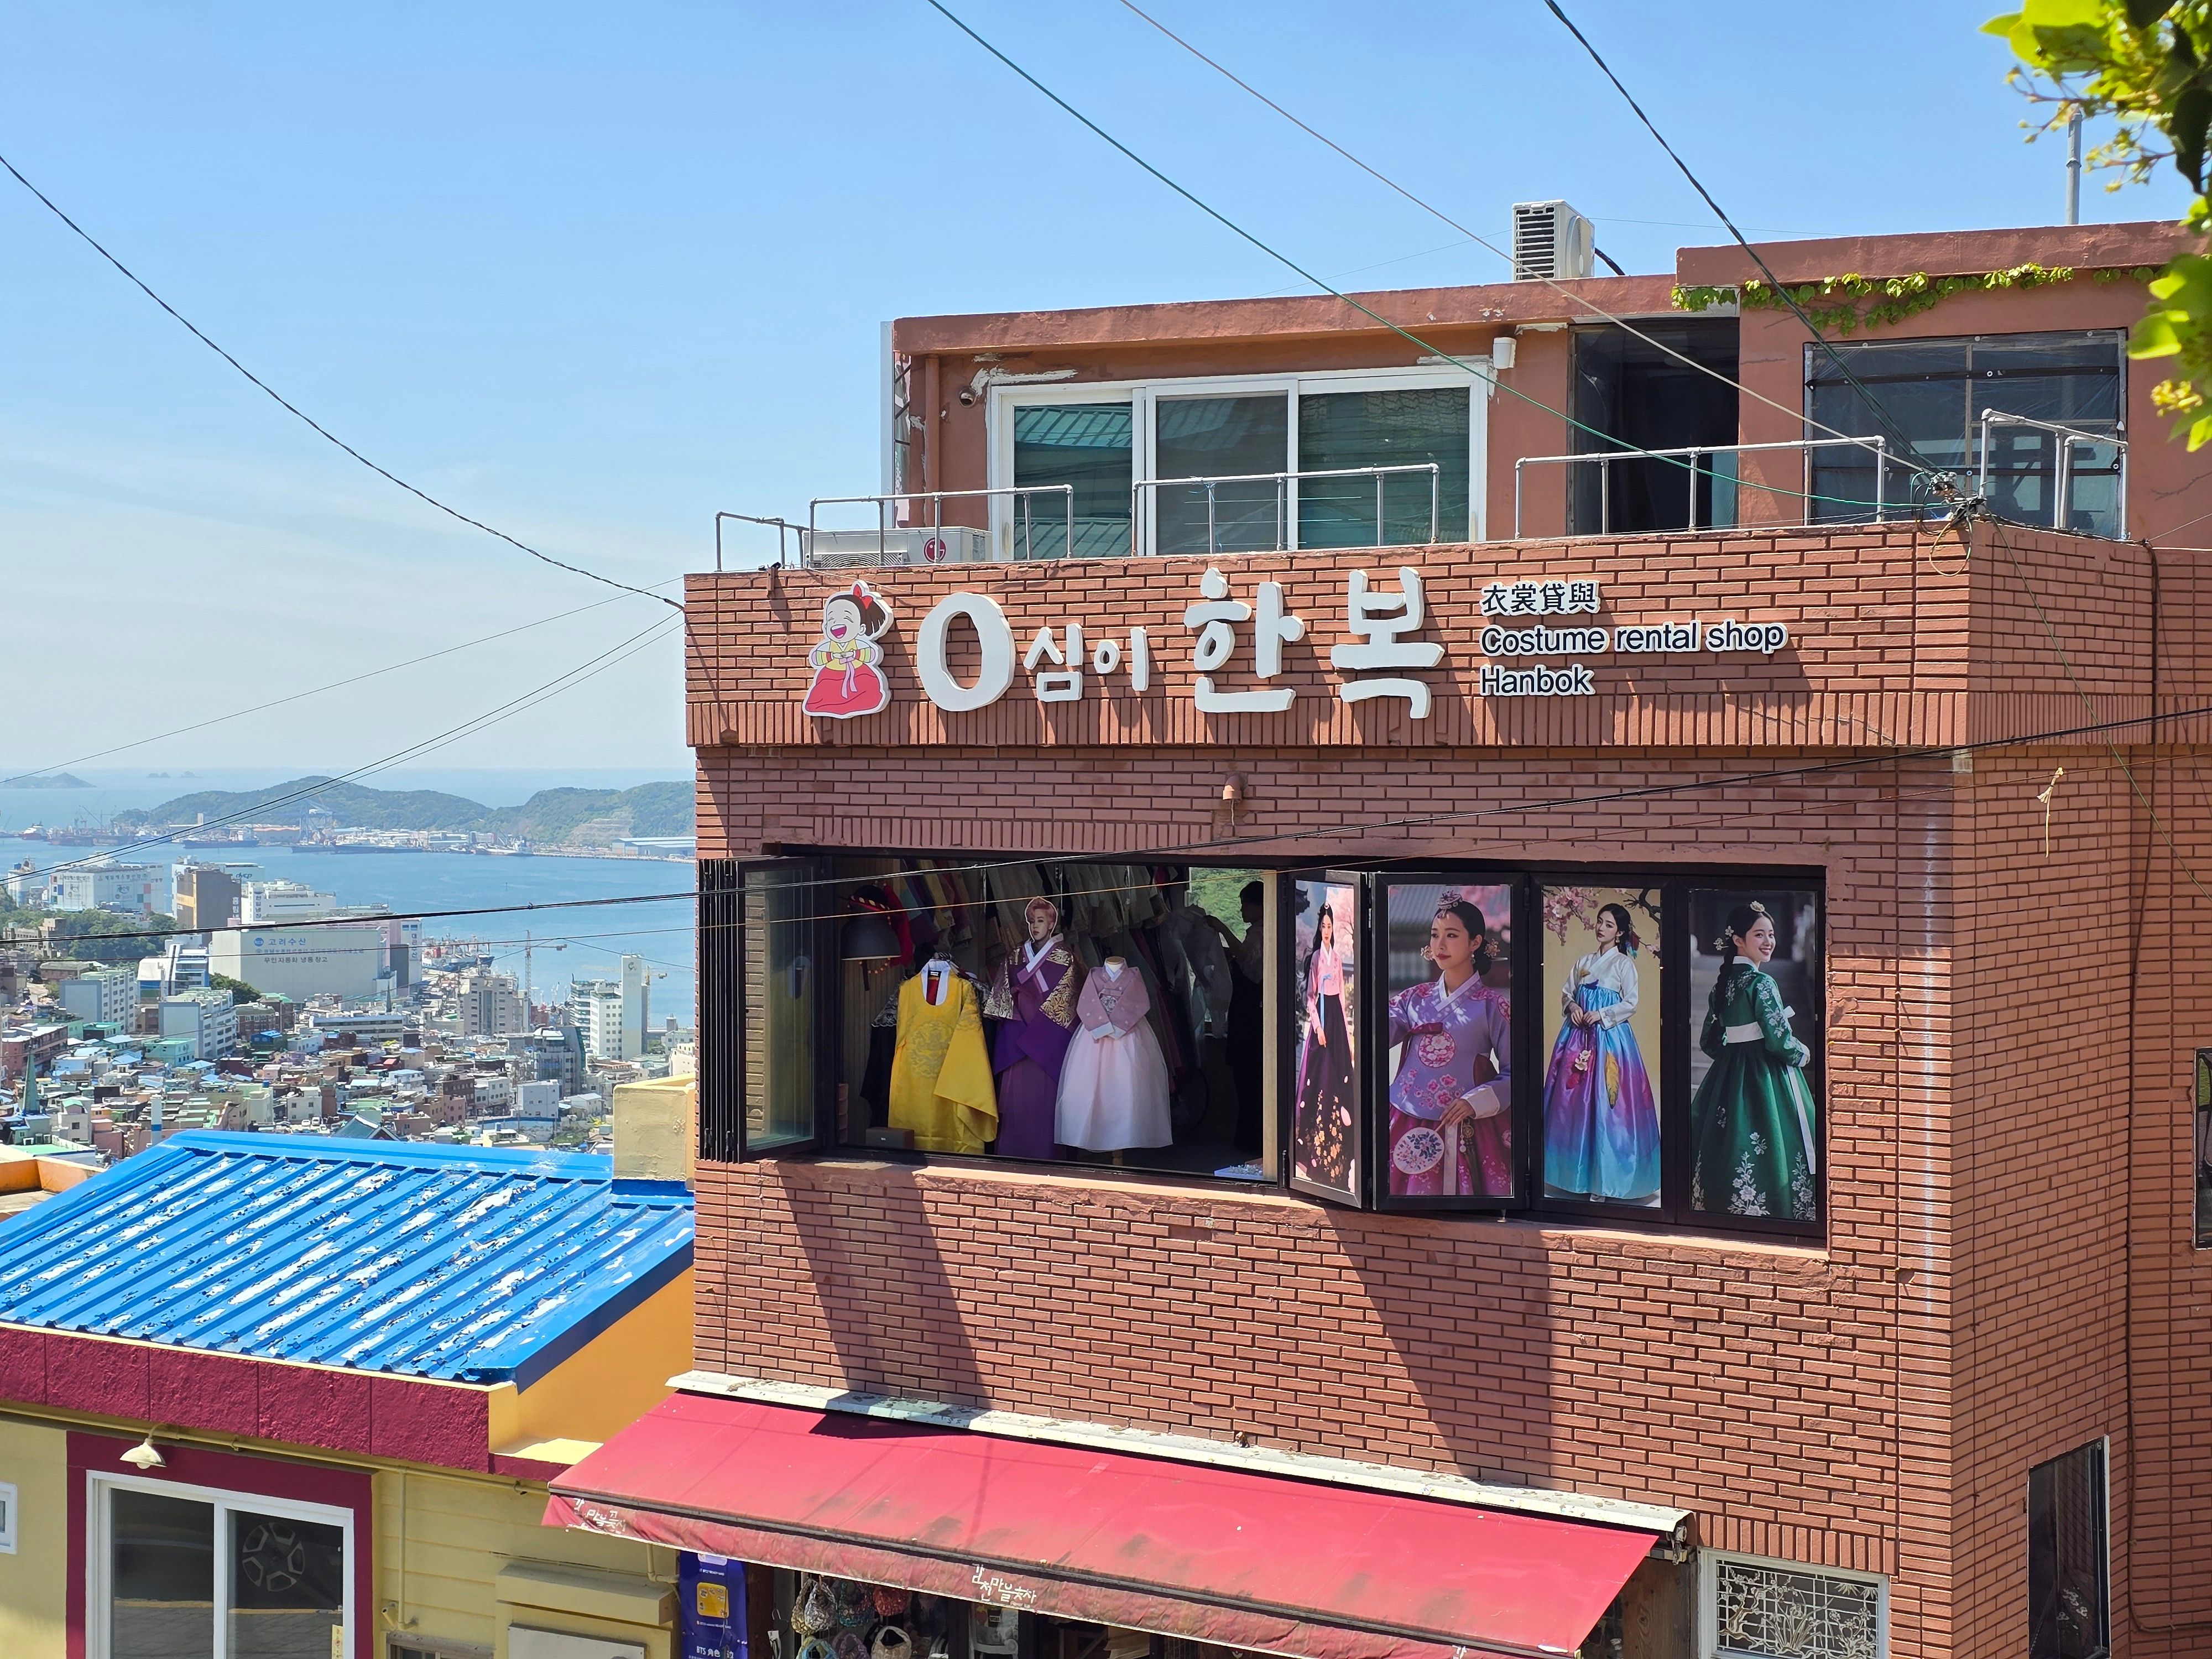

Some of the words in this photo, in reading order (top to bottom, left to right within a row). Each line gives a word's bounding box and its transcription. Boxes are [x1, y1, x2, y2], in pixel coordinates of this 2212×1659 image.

[1481, 582, 1596, 613] 衣裳貸與
[1183, 565, 1445, 719] 한복
[1481, 628, 1605, 654] Costume
[1616, 622, 1697, 649] rental
[1708, 621, 1783, 651] shop
[1481, 666, 1590, 694] Hanbok
[268, 937, 306, 946] 고려수산
